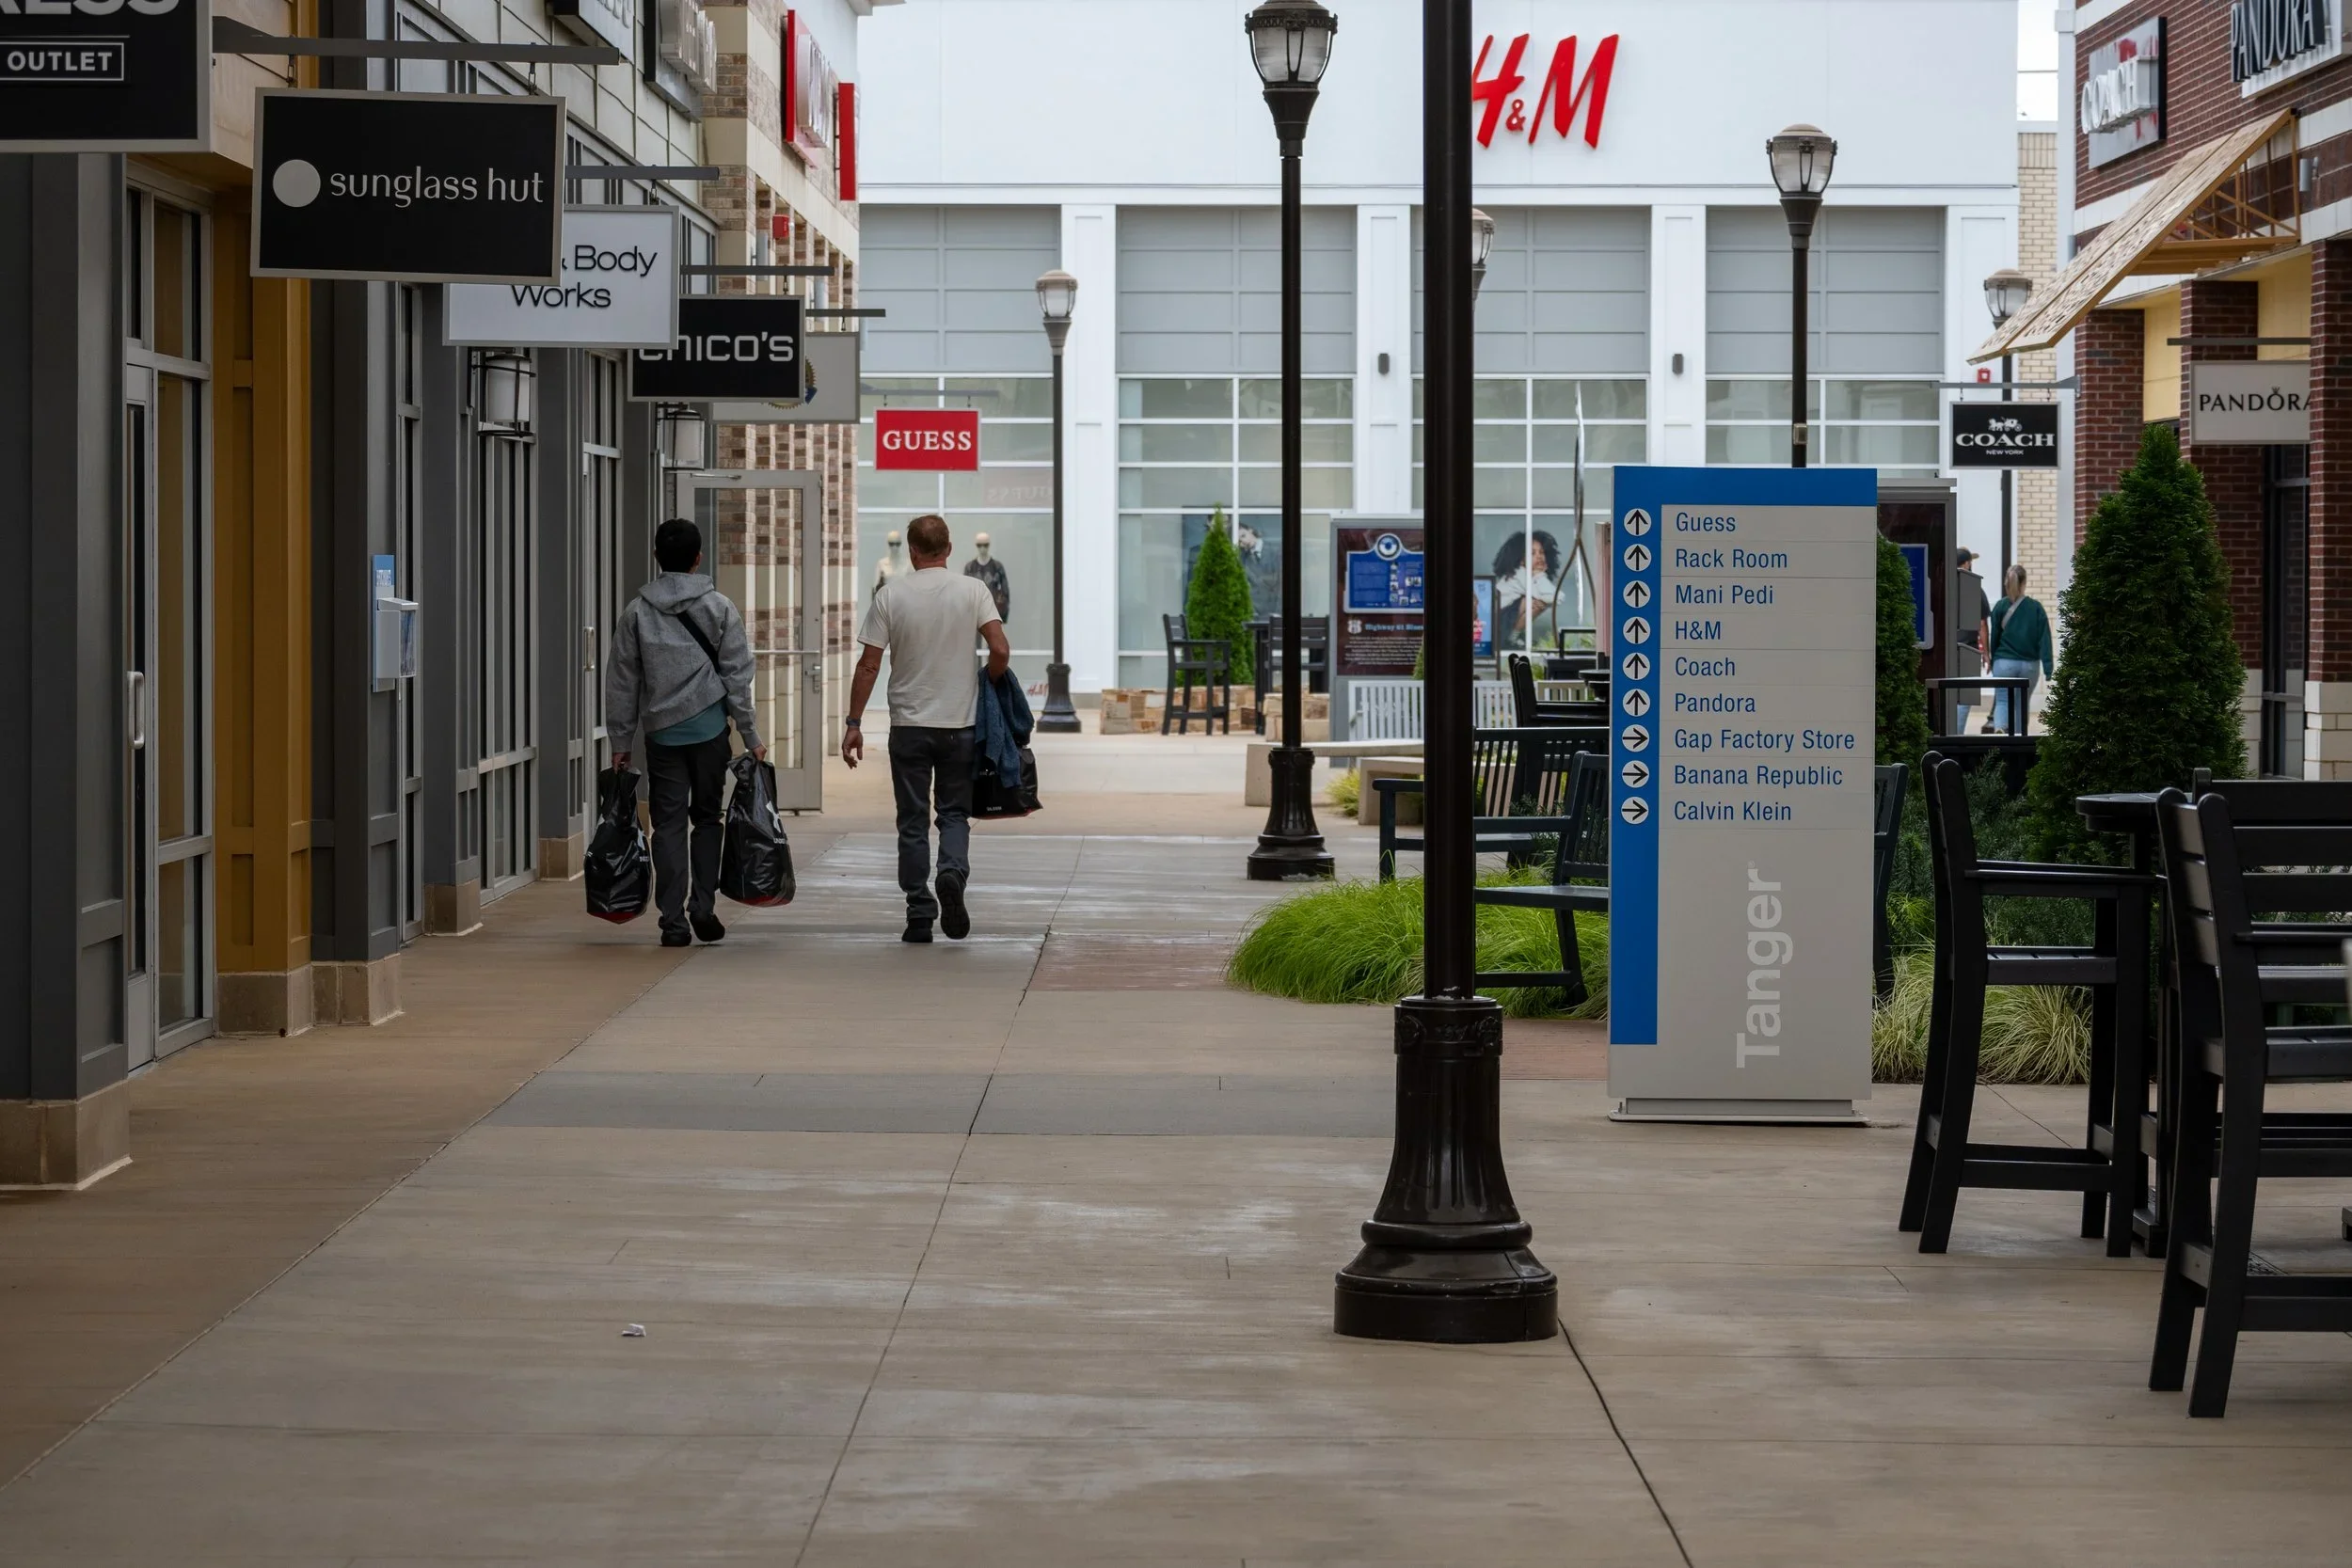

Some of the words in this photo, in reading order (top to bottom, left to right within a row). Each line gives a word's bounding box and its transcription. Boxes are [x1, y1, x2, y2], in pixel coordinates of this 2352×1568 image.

[7, 51, 113, 71] OUTLET
[1472, 33, 1619, 149] H&M
[2081, 57, 2138, 135] COACH
[330, 166, 478, 208] sunglass
[487, 167, 544, 203] hut
[574, 245, 658, 277] Body
[511, 284, 612, 309] Works
[882, 430, 972, 451] GUESS
[1955, 433, 2055, 447] COACH
[1676, 512, 1736, 532] Guess
[1676, 548, 1724, 568] Rack
[1732, 548, 1788, 569] Room
[1676, 584, 1723, 604] Mani
[1732, 584, 1773, 605] Pedi
[1676, 620, 1721, 641] H&M
[1675, 657, 1736, 676] Coach
[1675, 692, 1756, 713] Pandora
[1675, 728, 1712, 752] Gap
[1721, 729, 1794, 753] Factory
[1803, 729, 1855, 750] Store
[1675, 765, 1749, 784] Banana
[1756, 765, 1843, 789] Republic
[1674, 800, 1734, 820] Calvin
[1743, 801, 1791, 821] Klein
